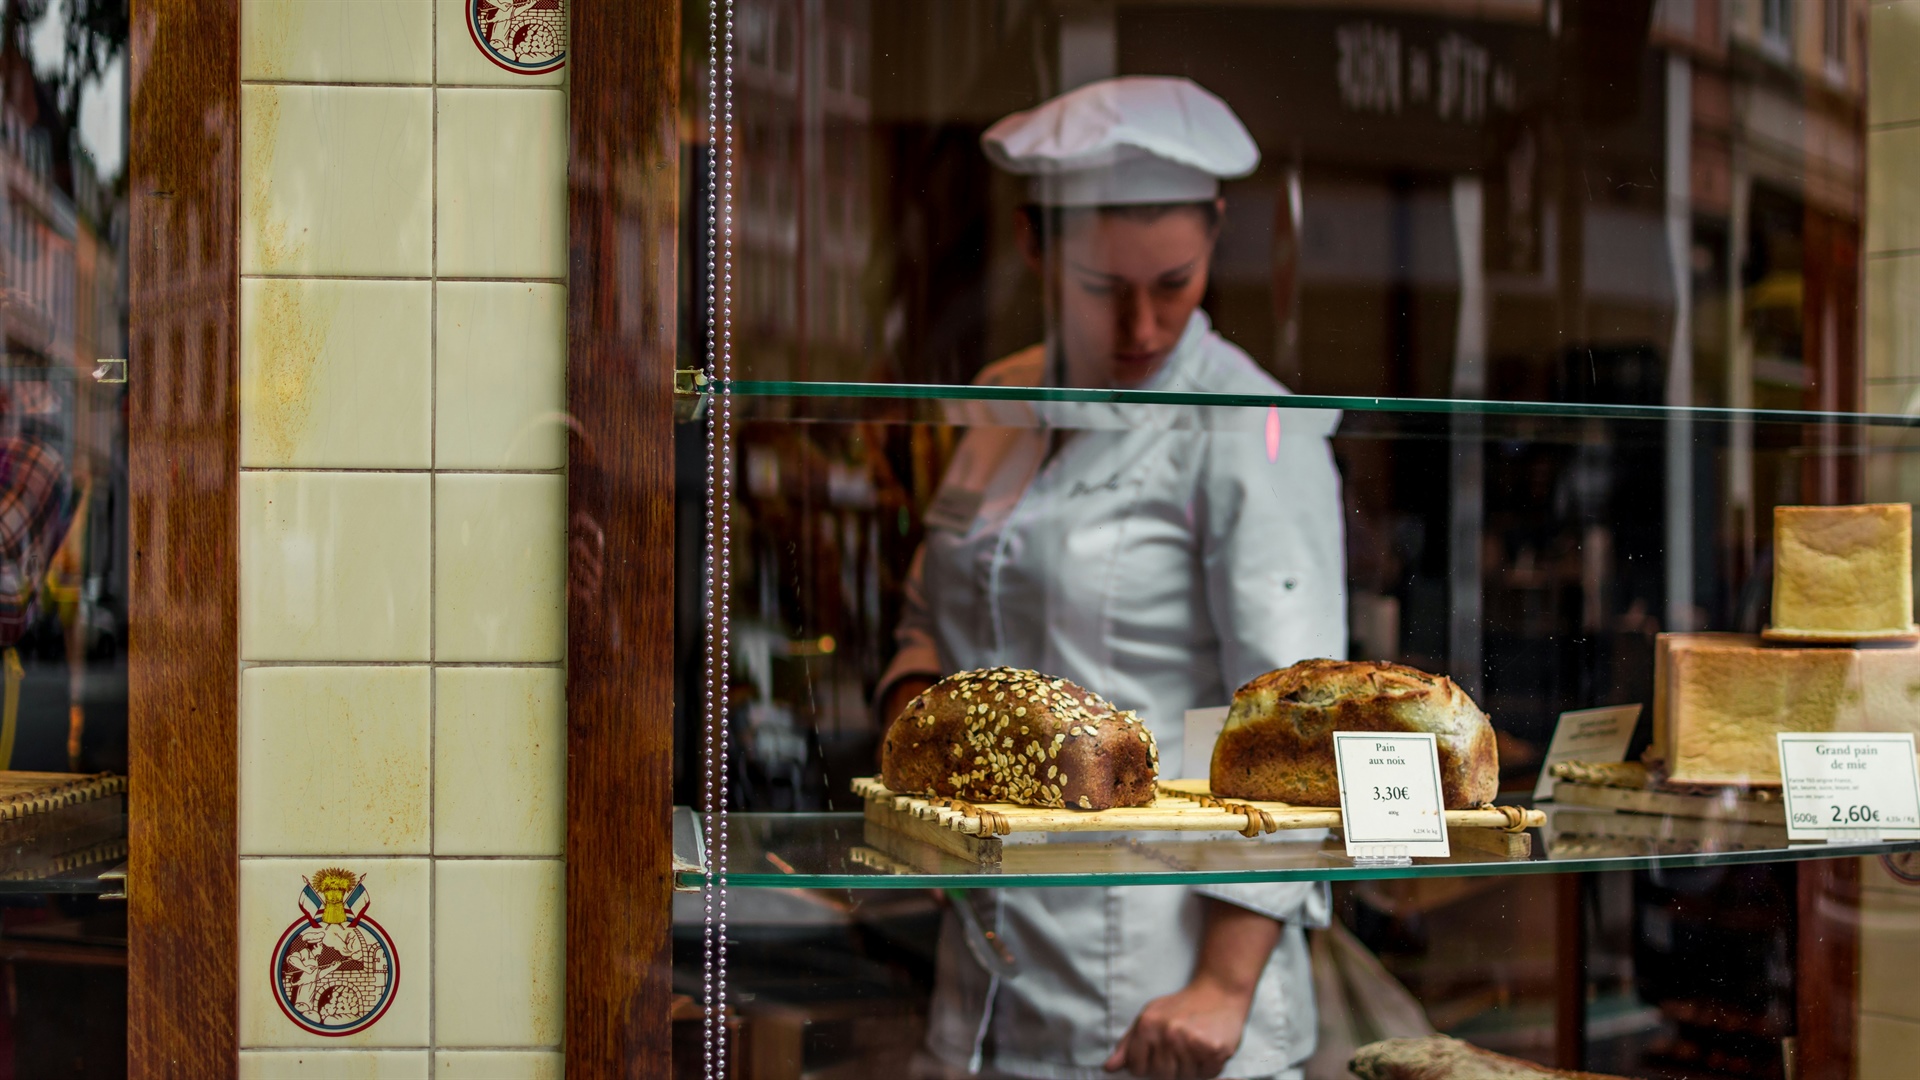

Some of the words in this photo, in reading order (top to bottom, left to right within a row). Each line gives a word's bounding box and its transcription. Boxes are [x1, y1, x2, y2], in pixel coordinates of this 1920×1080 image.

[1375, 743, 1395, 752] Pain
[1816, 744, 1851, 755] Grand
[1854, 744, 1878, 758] pain
[1386, 756, 1406, 765] noix
[1831, 760, 1844, 770] de
[1847, 760, 1867, 770] mie
[1373, 786, 1410, 802] 3,30€
[1793, 812, 1818, 825] 600g
[1830, 805, 1881, 824] 2,60€
